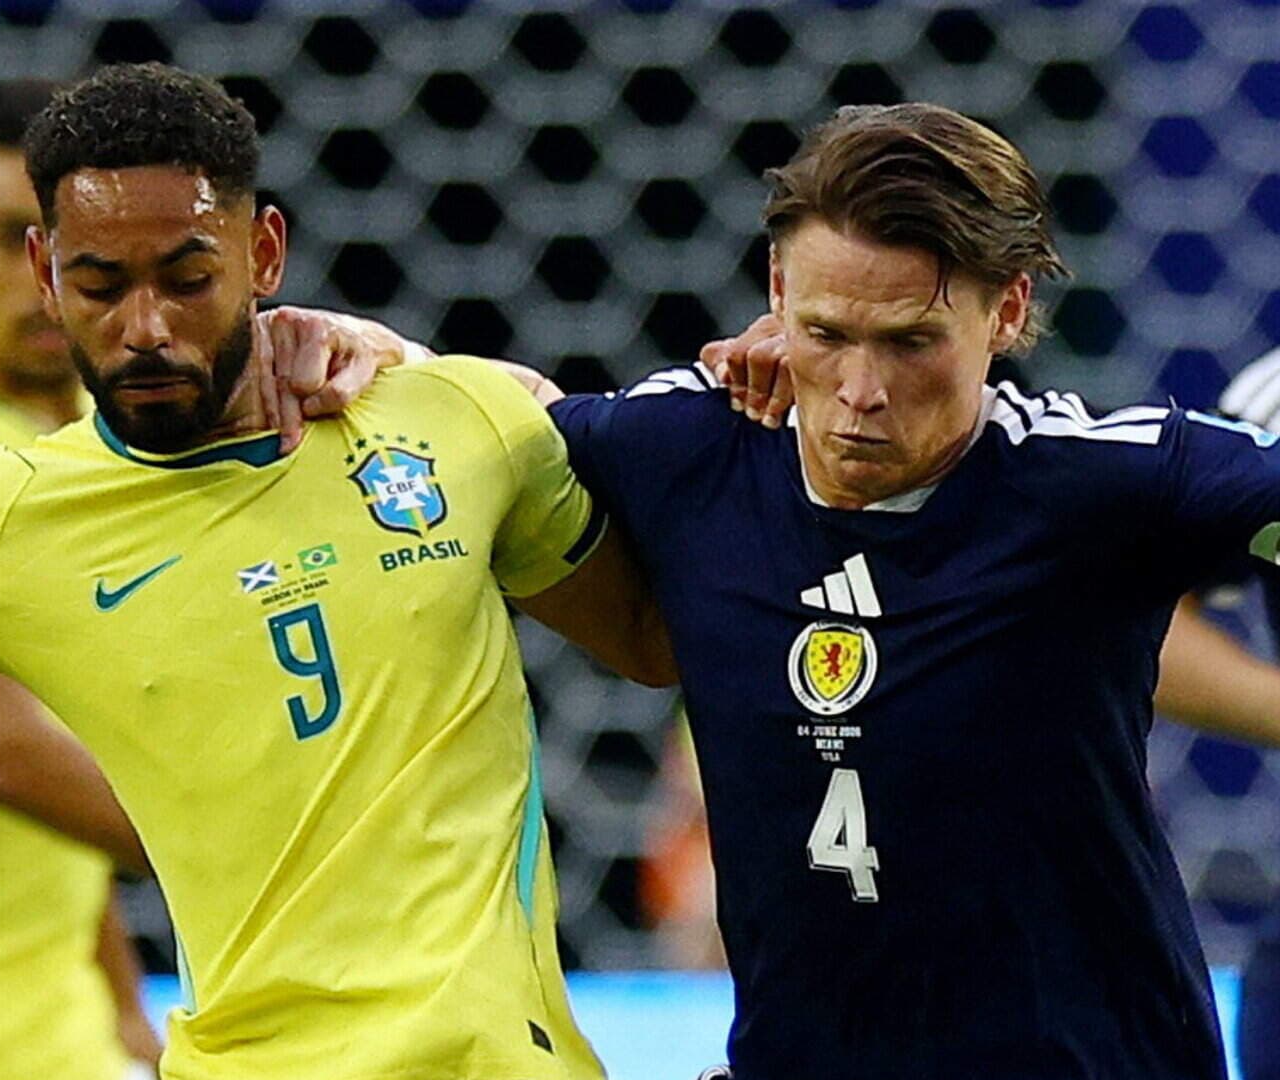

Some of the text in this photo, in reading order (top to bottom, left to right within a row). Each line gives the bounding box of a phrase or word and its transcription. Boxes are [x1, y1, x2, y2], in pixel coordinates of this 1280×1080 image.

[386, 481, 418, 497] CBF
[379, 539, 469, 572] BRASIL
[268, 602, 342, 741] 9
[807, 768, 880, 902] 4
